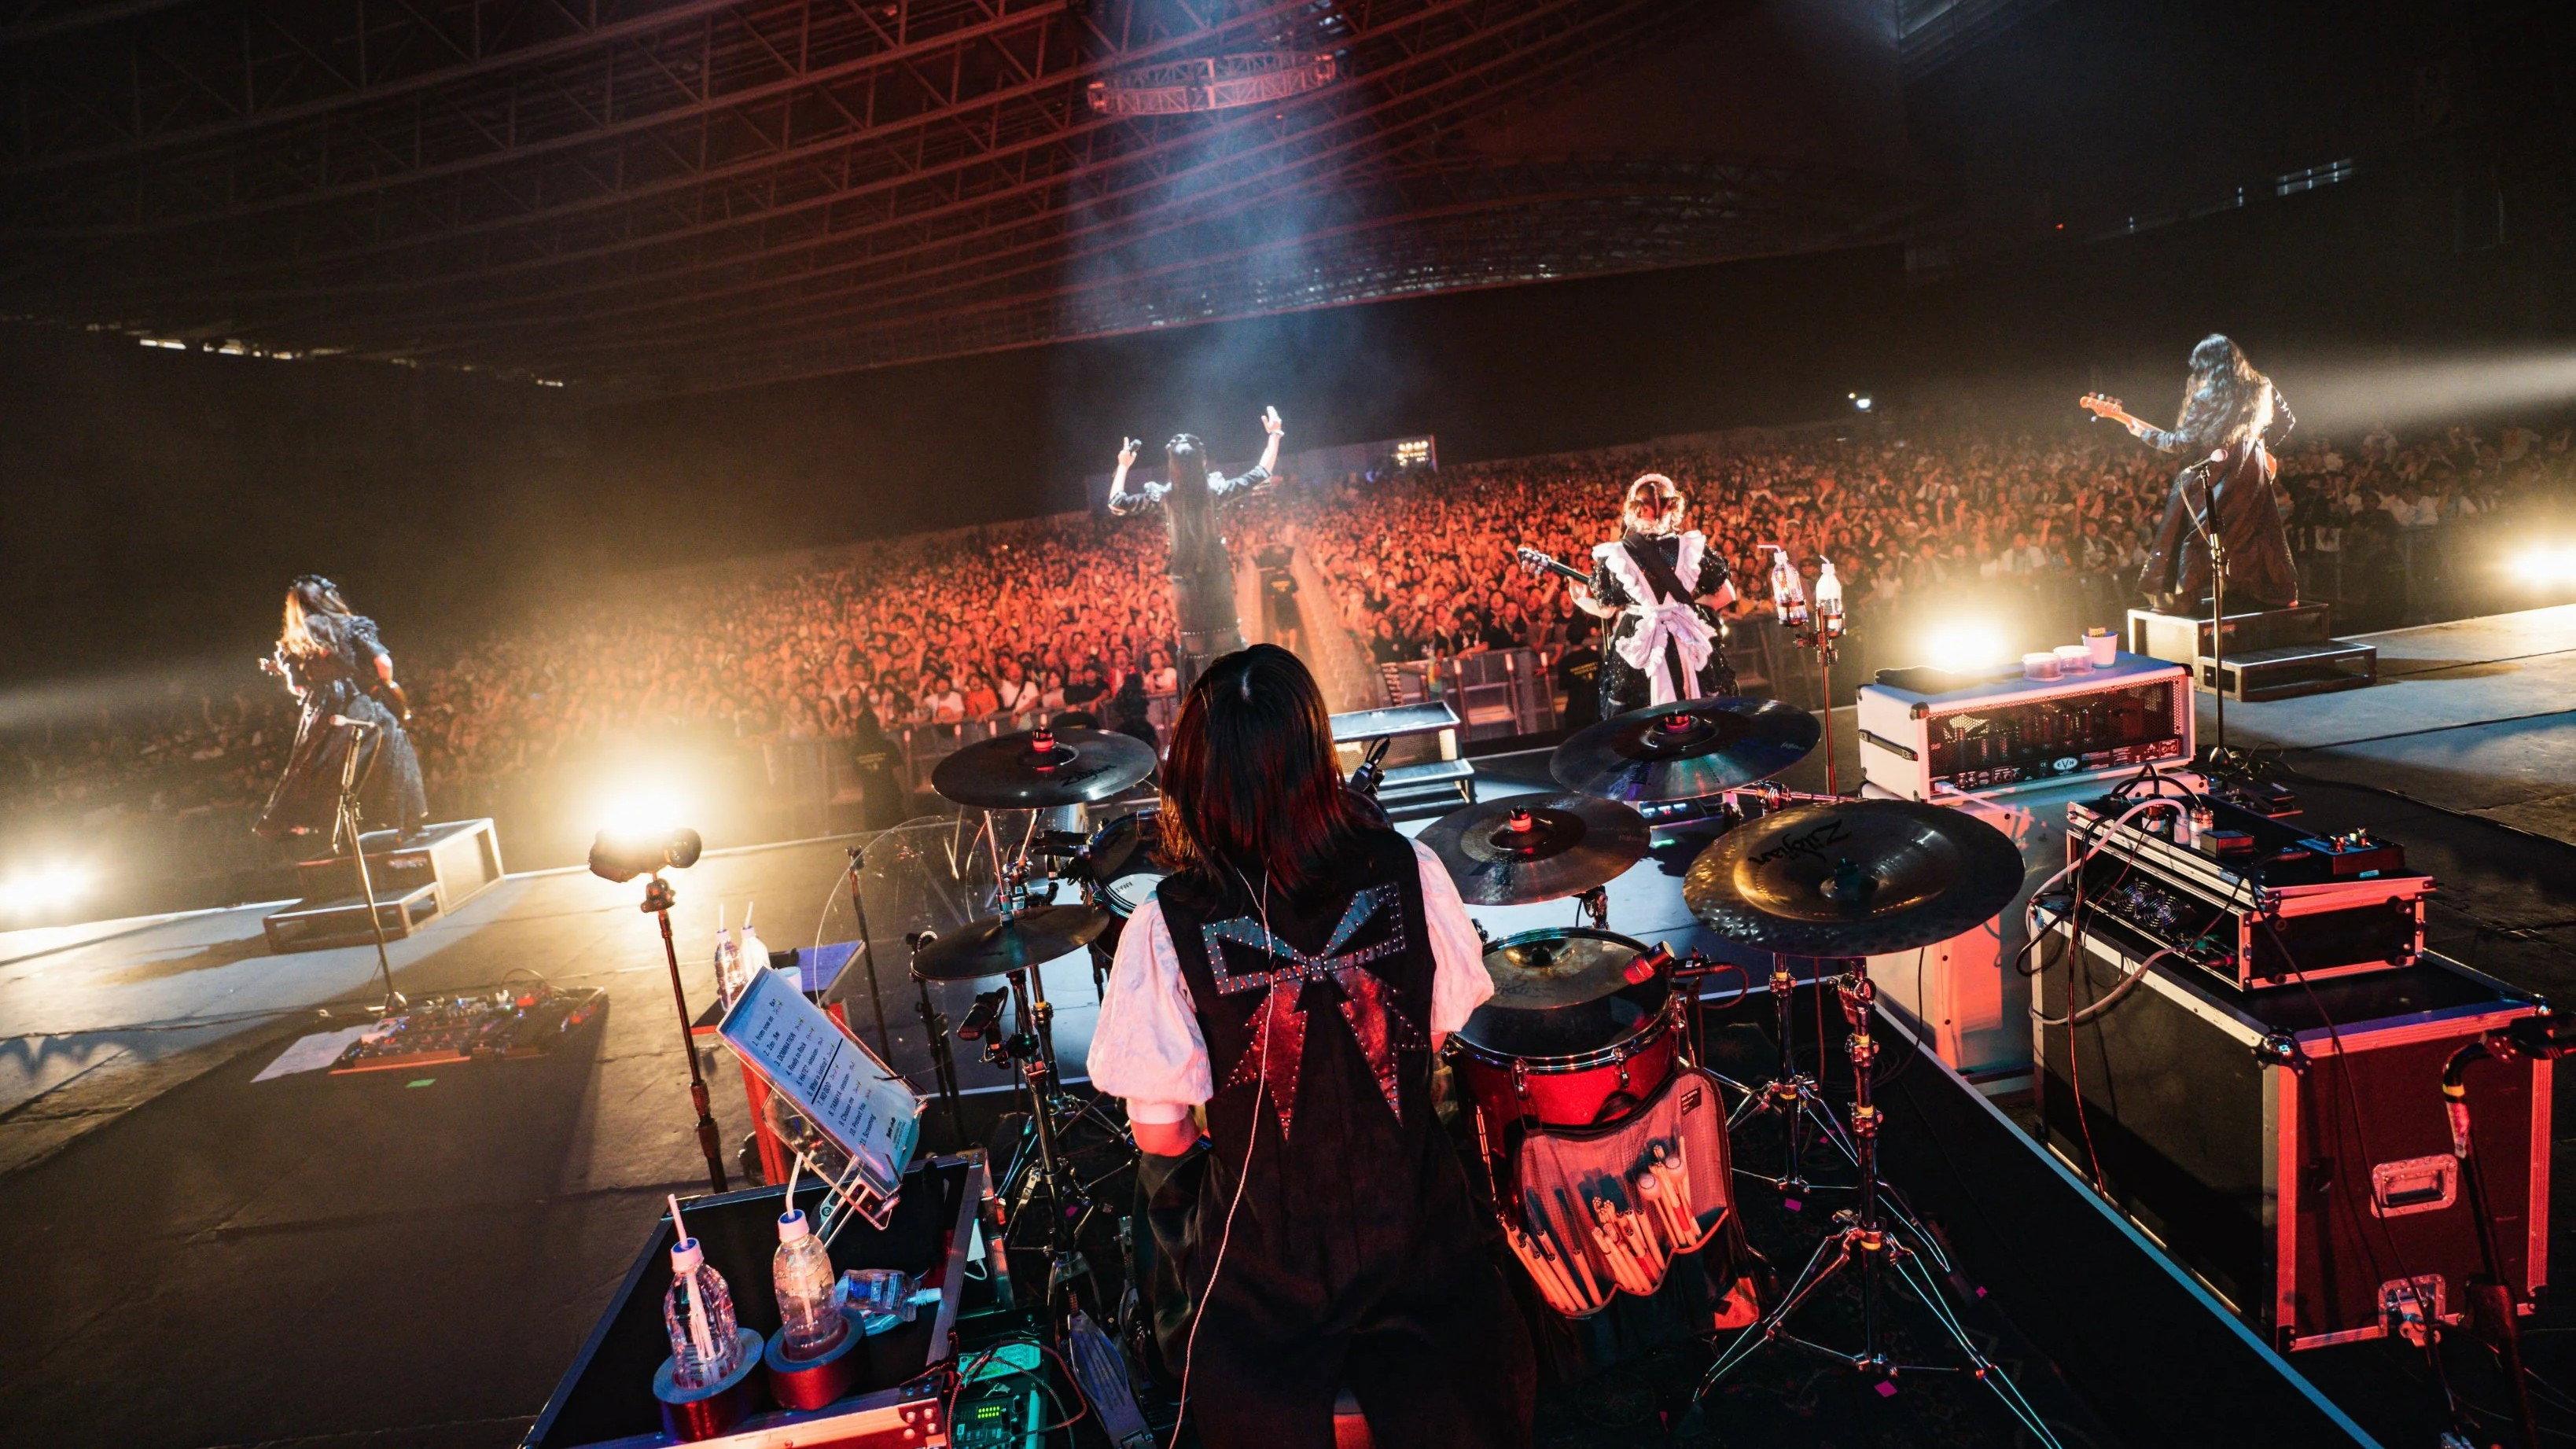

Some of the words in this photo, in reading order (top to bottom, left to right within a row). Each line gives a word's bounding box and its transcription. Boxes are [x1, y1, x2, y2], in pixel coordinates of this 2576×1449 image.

[2057, 759, 2074, 770] EVH
[1059, 764, 1117, 787] Zildjian
[1747, 818, 1853, 866] Zildjian
[756, 1029, 765, 1041] from
[767, 1040, 775, 1050] Zen
[778, 1032, 796, 1061] DOMINATION
[788, 1057, 799, 1071] Ready
[797, 1042, 806, 1054] Rock
[799, 1065, 810, 1081] HATE?
[810, 1078, 819, 1091] What
[817, 1057, 828, 1076] justice?
[820, 1092, 827, 1101] NO
[841, 1103, 852, 1121] Choose
[852, 1110, 863, 1128] Protect
